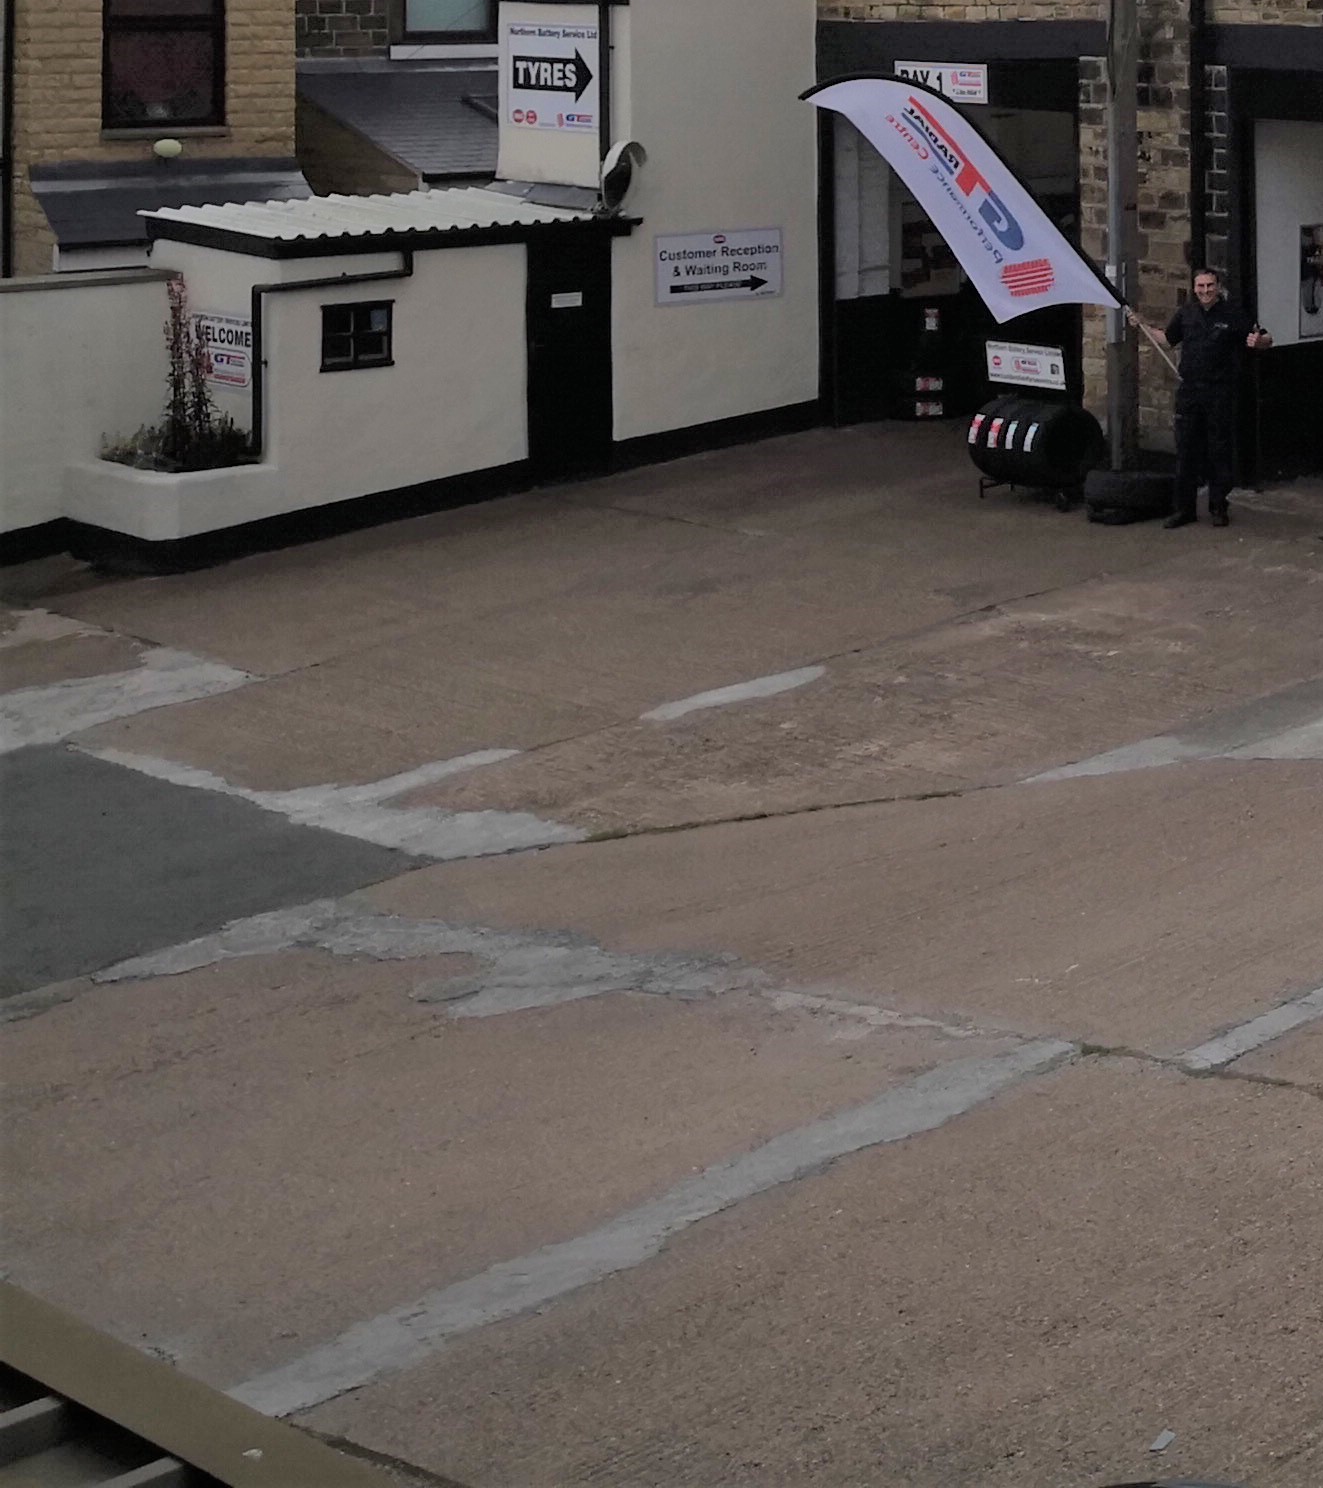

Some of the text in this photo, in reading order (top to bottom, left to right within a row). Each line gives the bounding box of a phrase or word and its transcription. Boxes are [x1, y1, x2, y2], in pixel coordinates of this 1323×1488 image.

[515, 61, 577, 87] TYRES
[659, 243, 780, 262] Customer Reception
[672, 261, 767, 277] & Waiting Room
